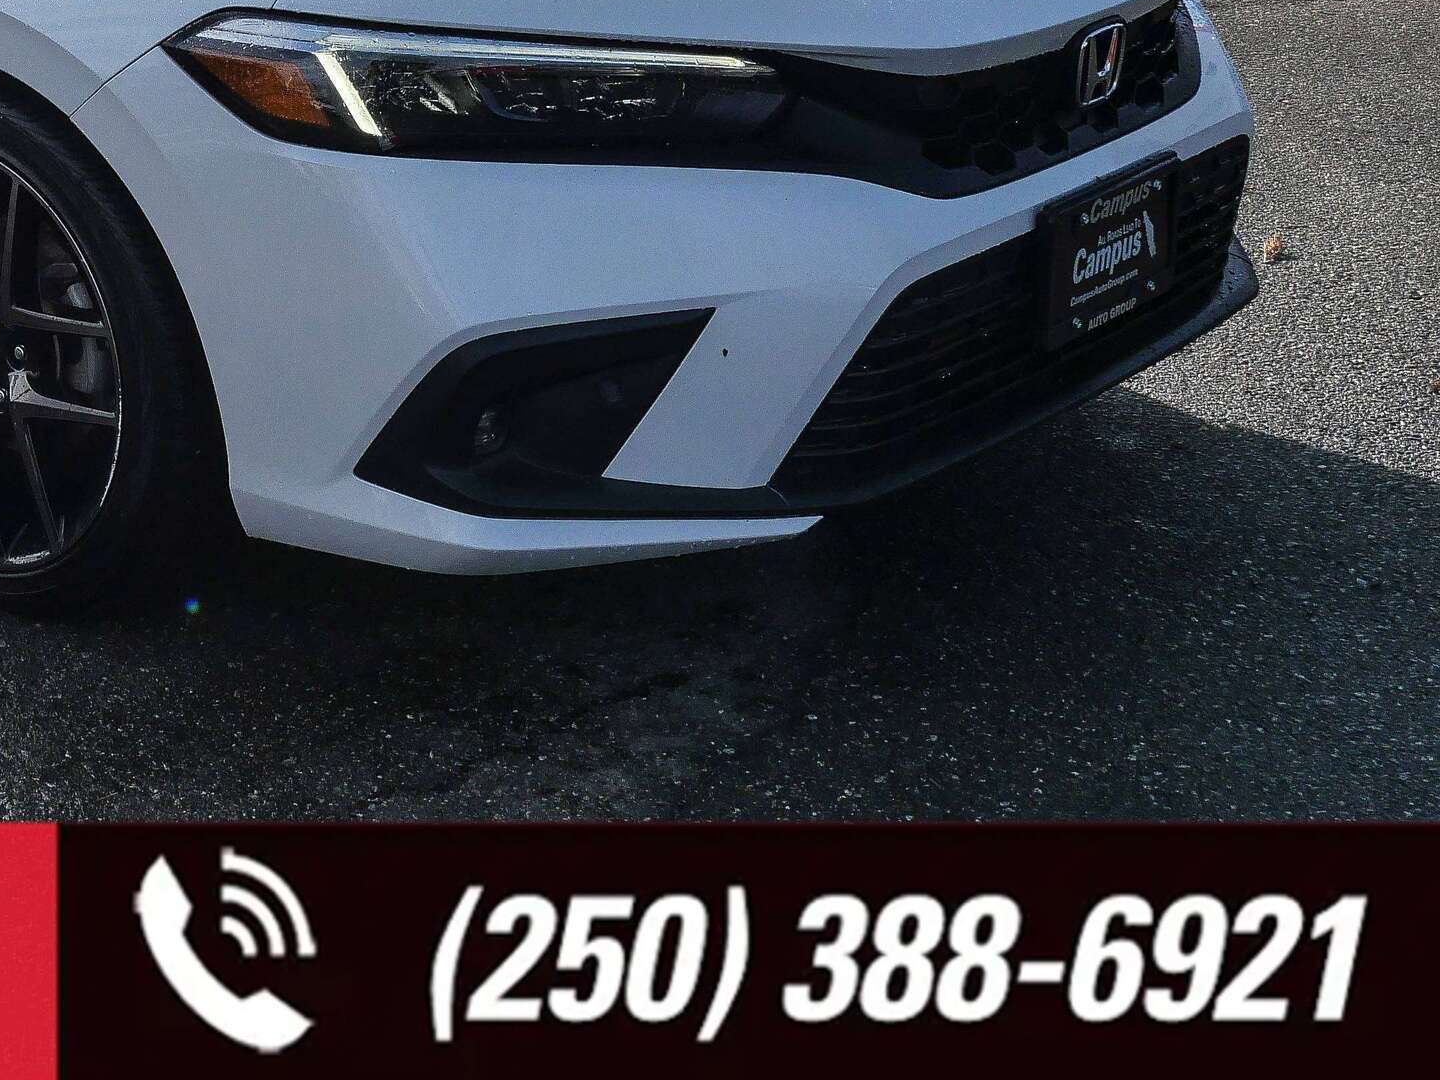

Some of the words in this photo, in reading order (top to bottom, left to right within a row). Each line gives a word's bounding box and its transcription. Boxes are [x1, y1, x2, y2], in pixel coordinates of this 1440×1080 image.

[1089, 180, 1152, 224] Campus
[1072, 230, 1142, 284] Campus
[1088, 310, 1109, 331] AUTO
[1110, 297, 1137, 320] GROUP
